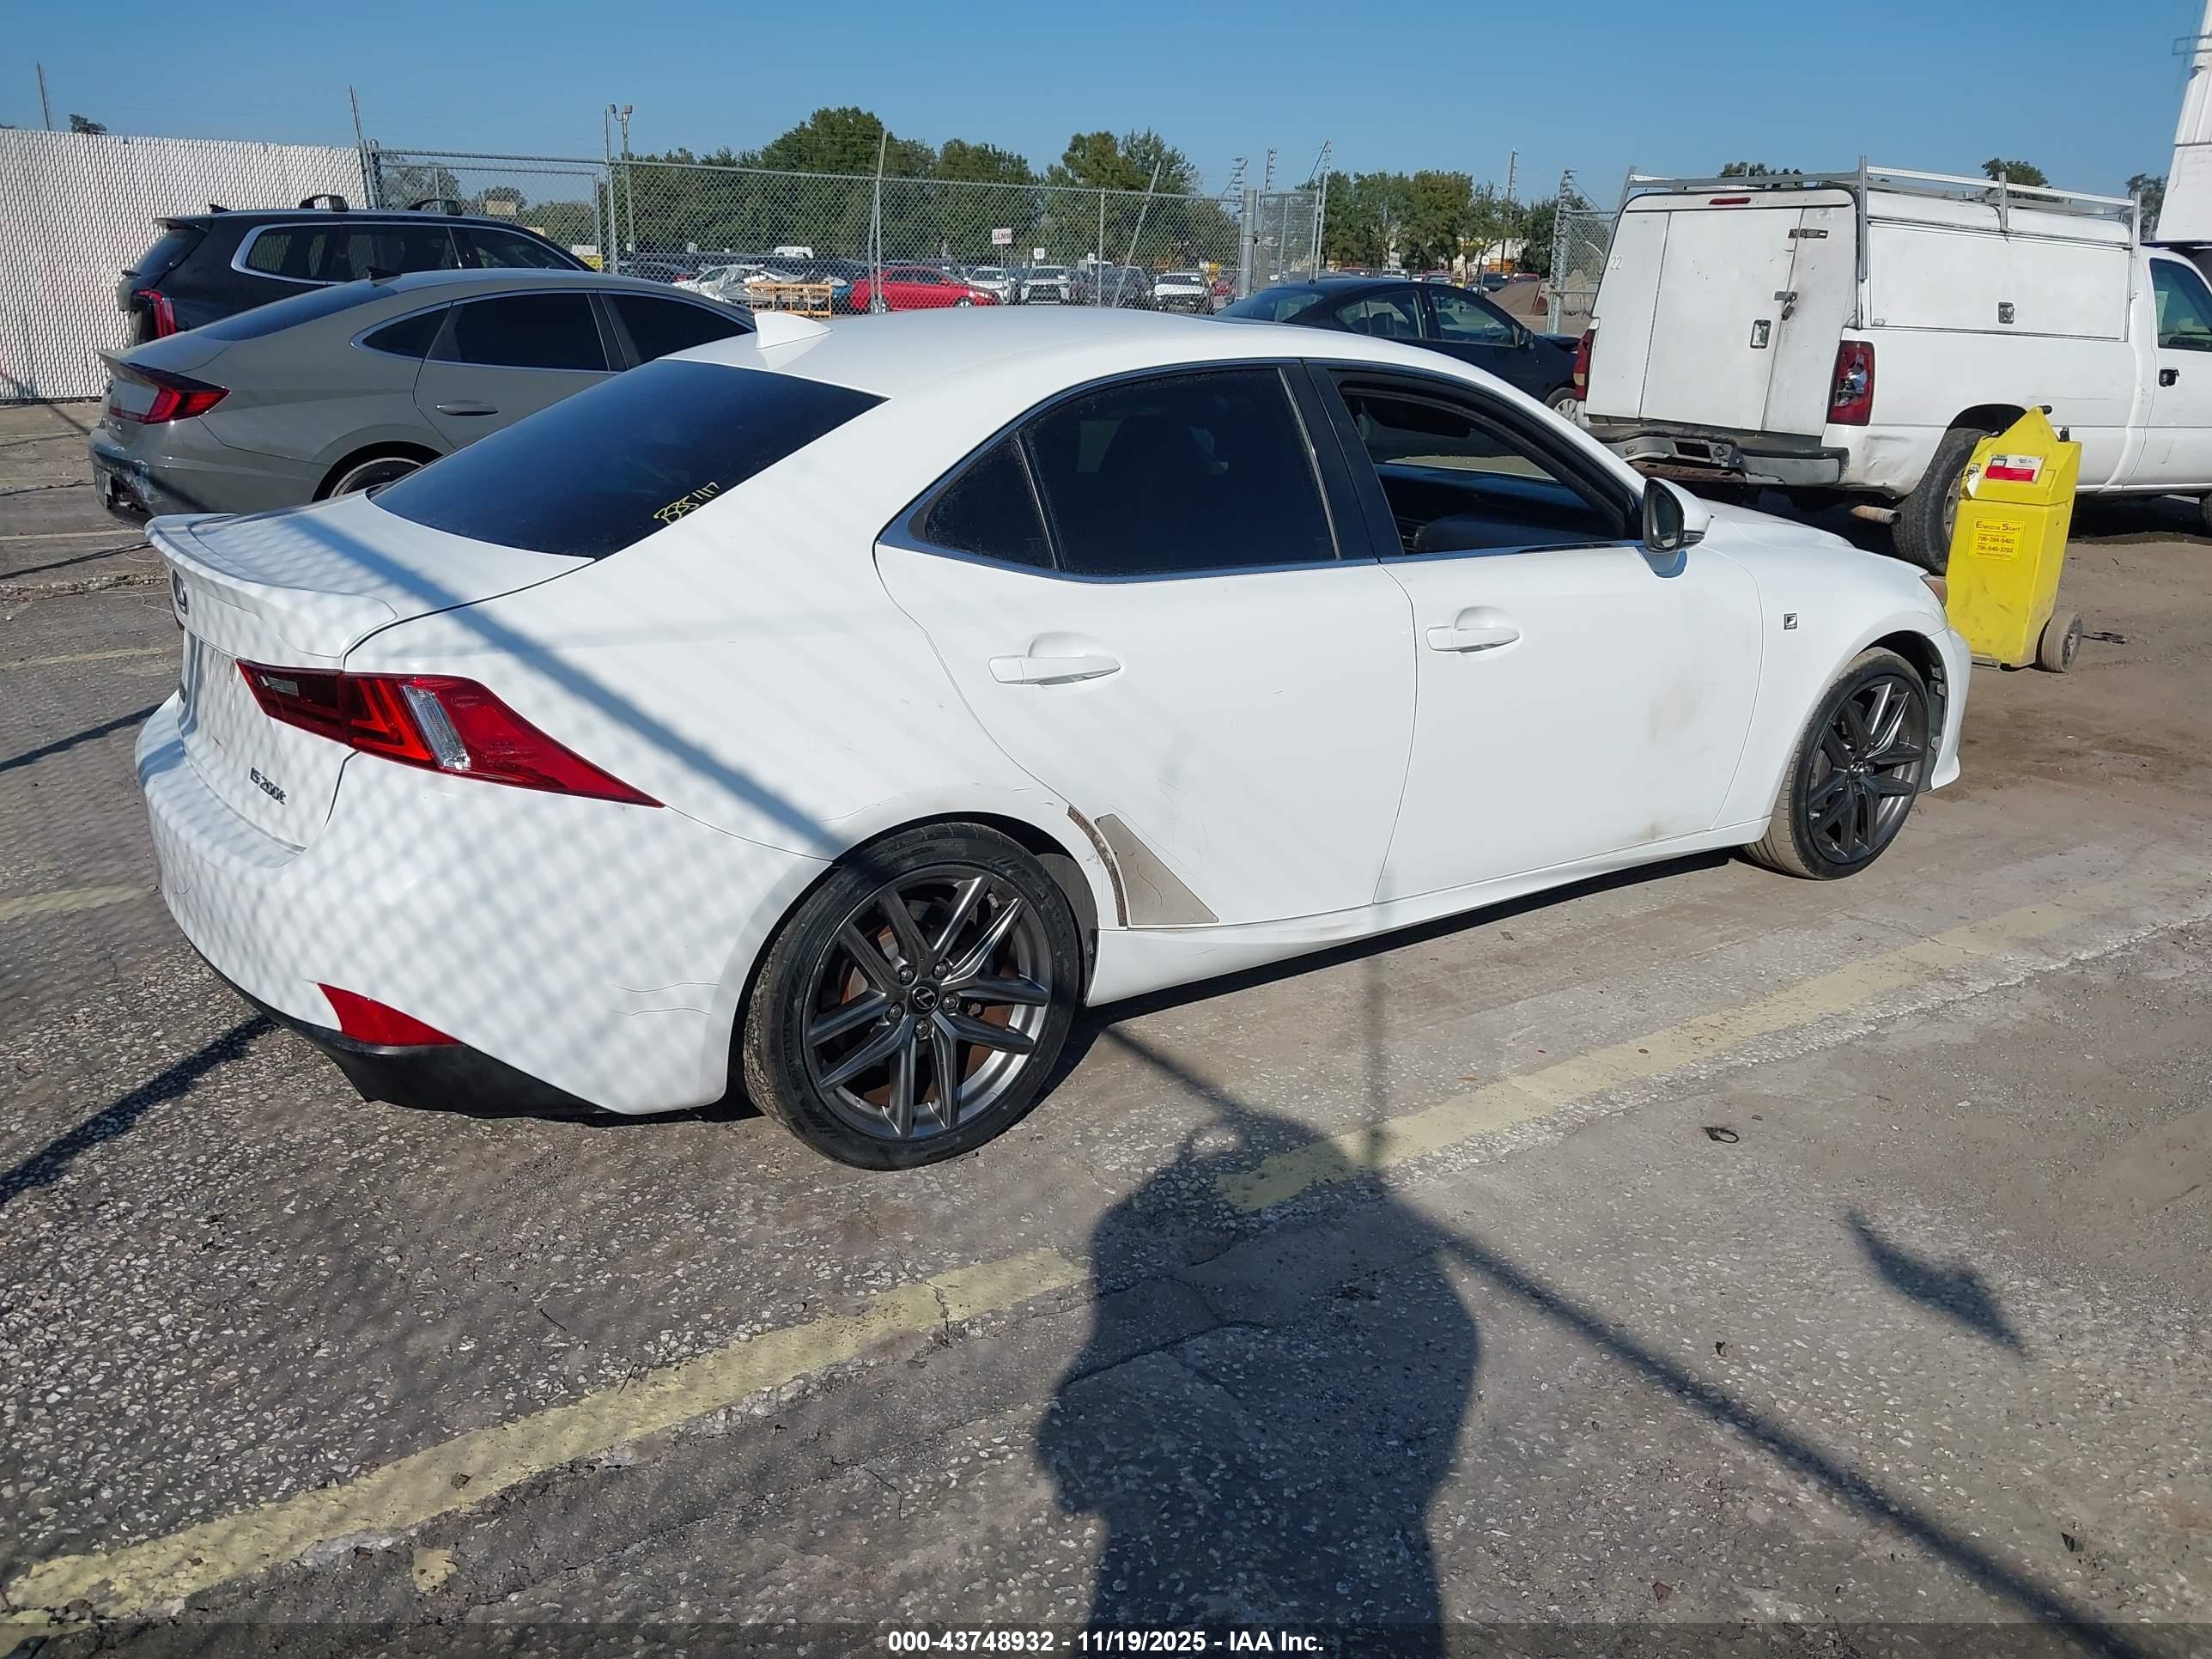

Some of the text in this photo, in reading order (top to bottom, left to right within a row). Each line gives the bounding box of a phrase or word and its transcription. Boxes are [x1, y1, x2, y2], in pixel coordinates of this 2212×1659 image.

[1610, 256, 1622, 270] 22
[1975, 520, 2001, 531] Electra
[2002, 523, 2021, 532] Start
